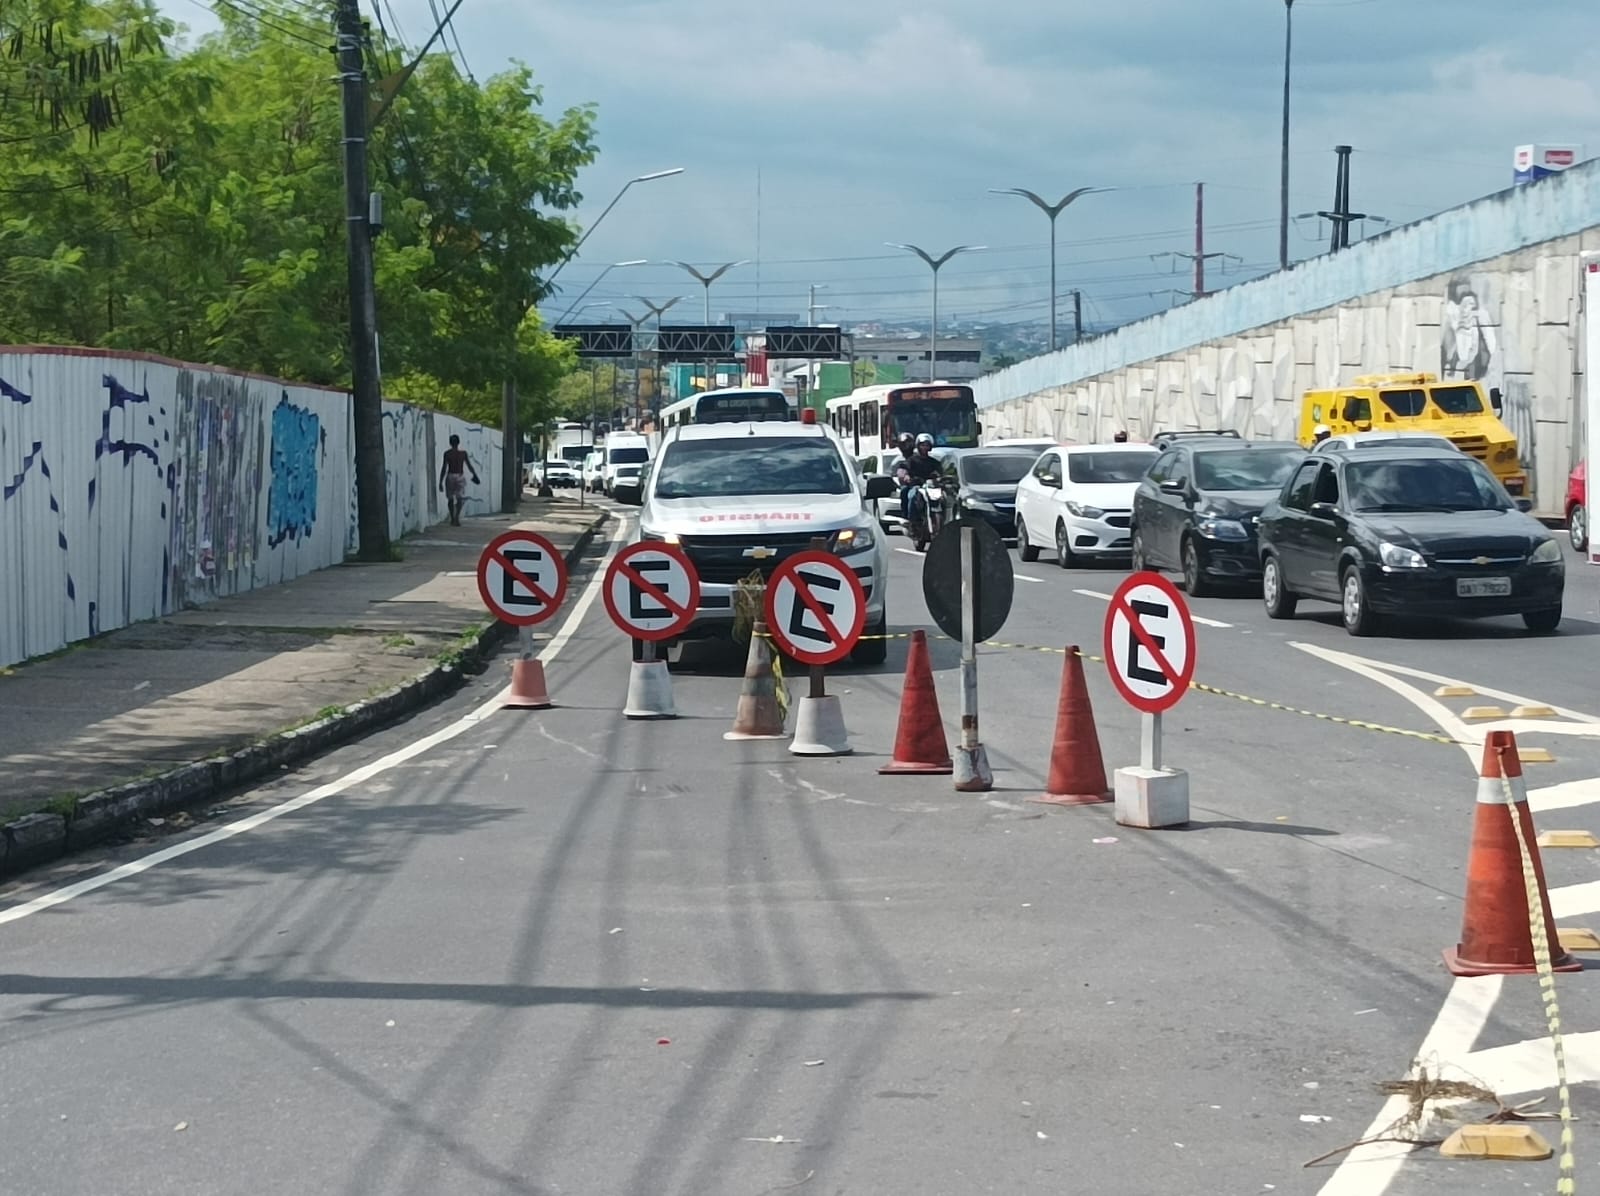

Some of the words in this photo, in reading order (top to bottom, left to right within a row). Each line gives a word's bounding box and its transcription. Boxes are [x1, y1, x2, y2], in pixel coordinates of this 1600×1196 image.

[503, 550, 542, 605] E
[629, 560, 673, 618] E
[789, 571, 841, 643] E
[1128, 600, 1168, 686] E
